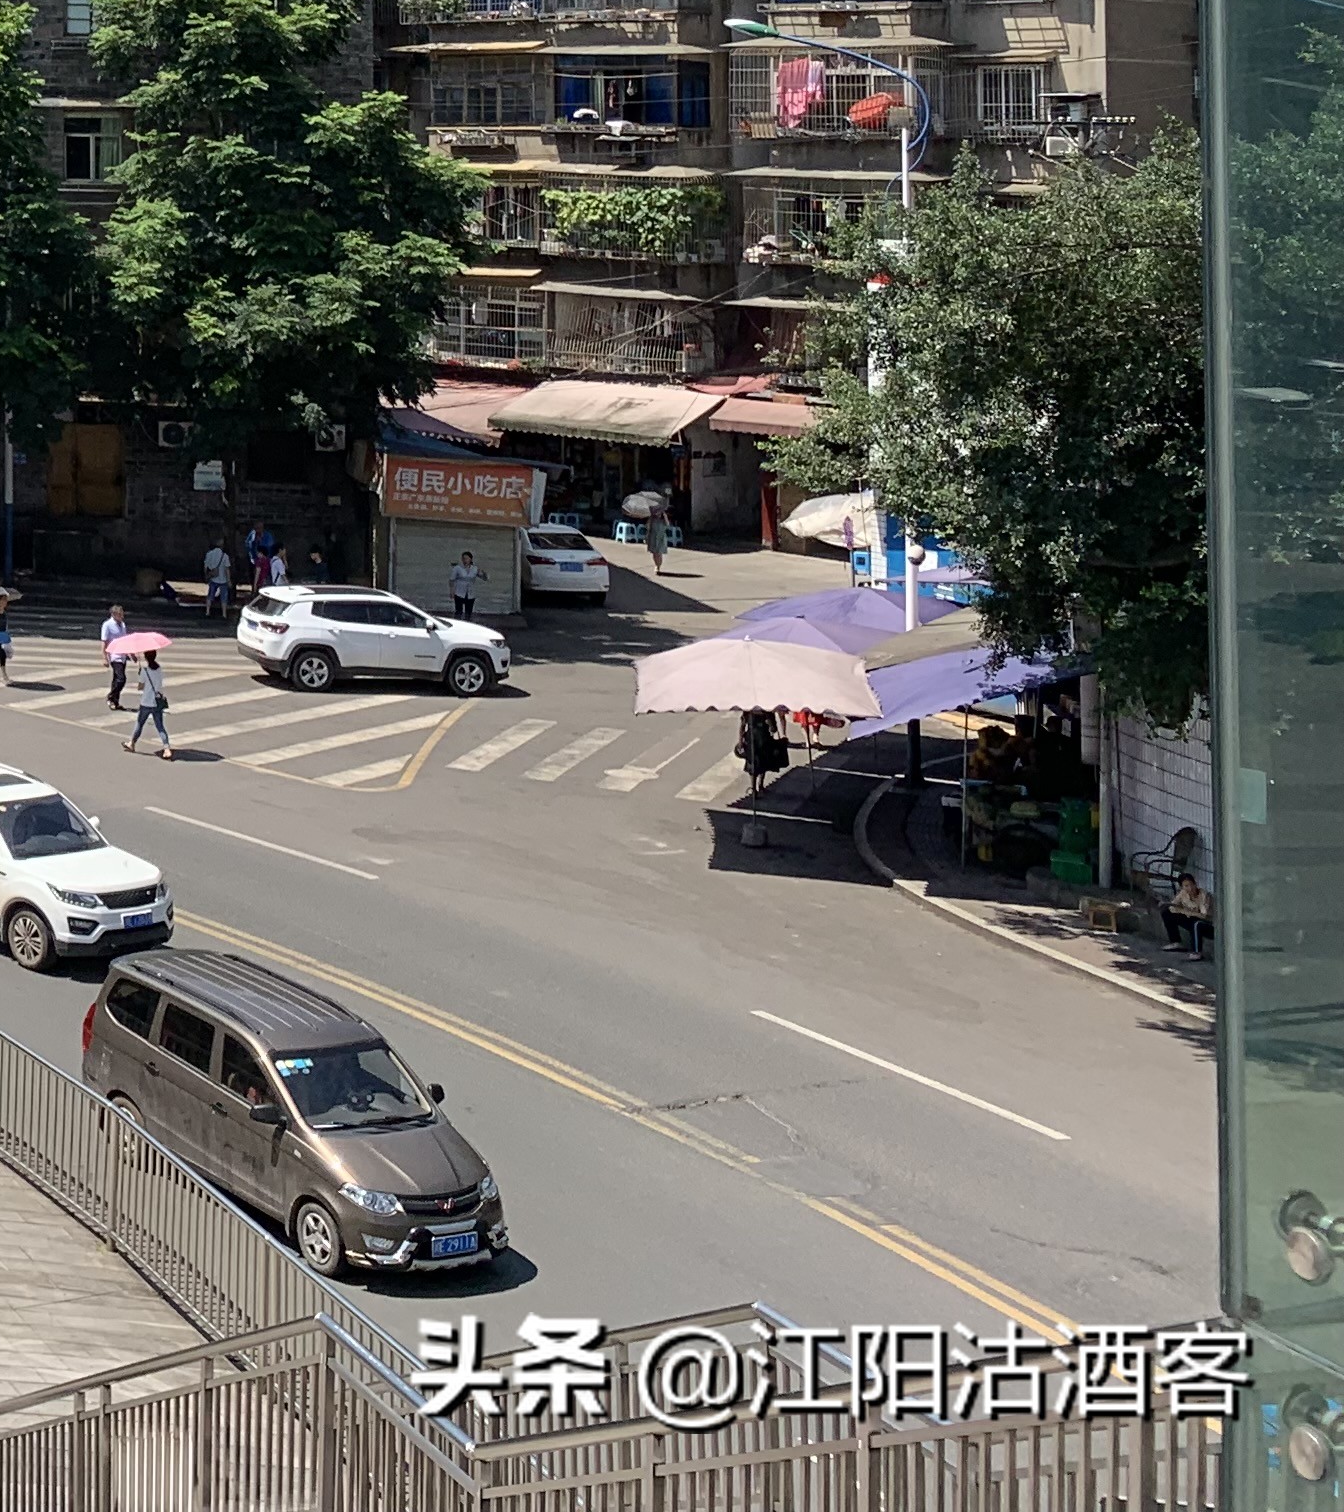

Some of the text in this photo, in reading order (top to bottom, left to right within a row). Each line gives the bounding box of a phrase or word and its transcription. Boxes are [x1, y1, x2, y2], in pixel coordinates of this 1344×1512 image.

[395, 467, 525, 499] 便民小吃店
